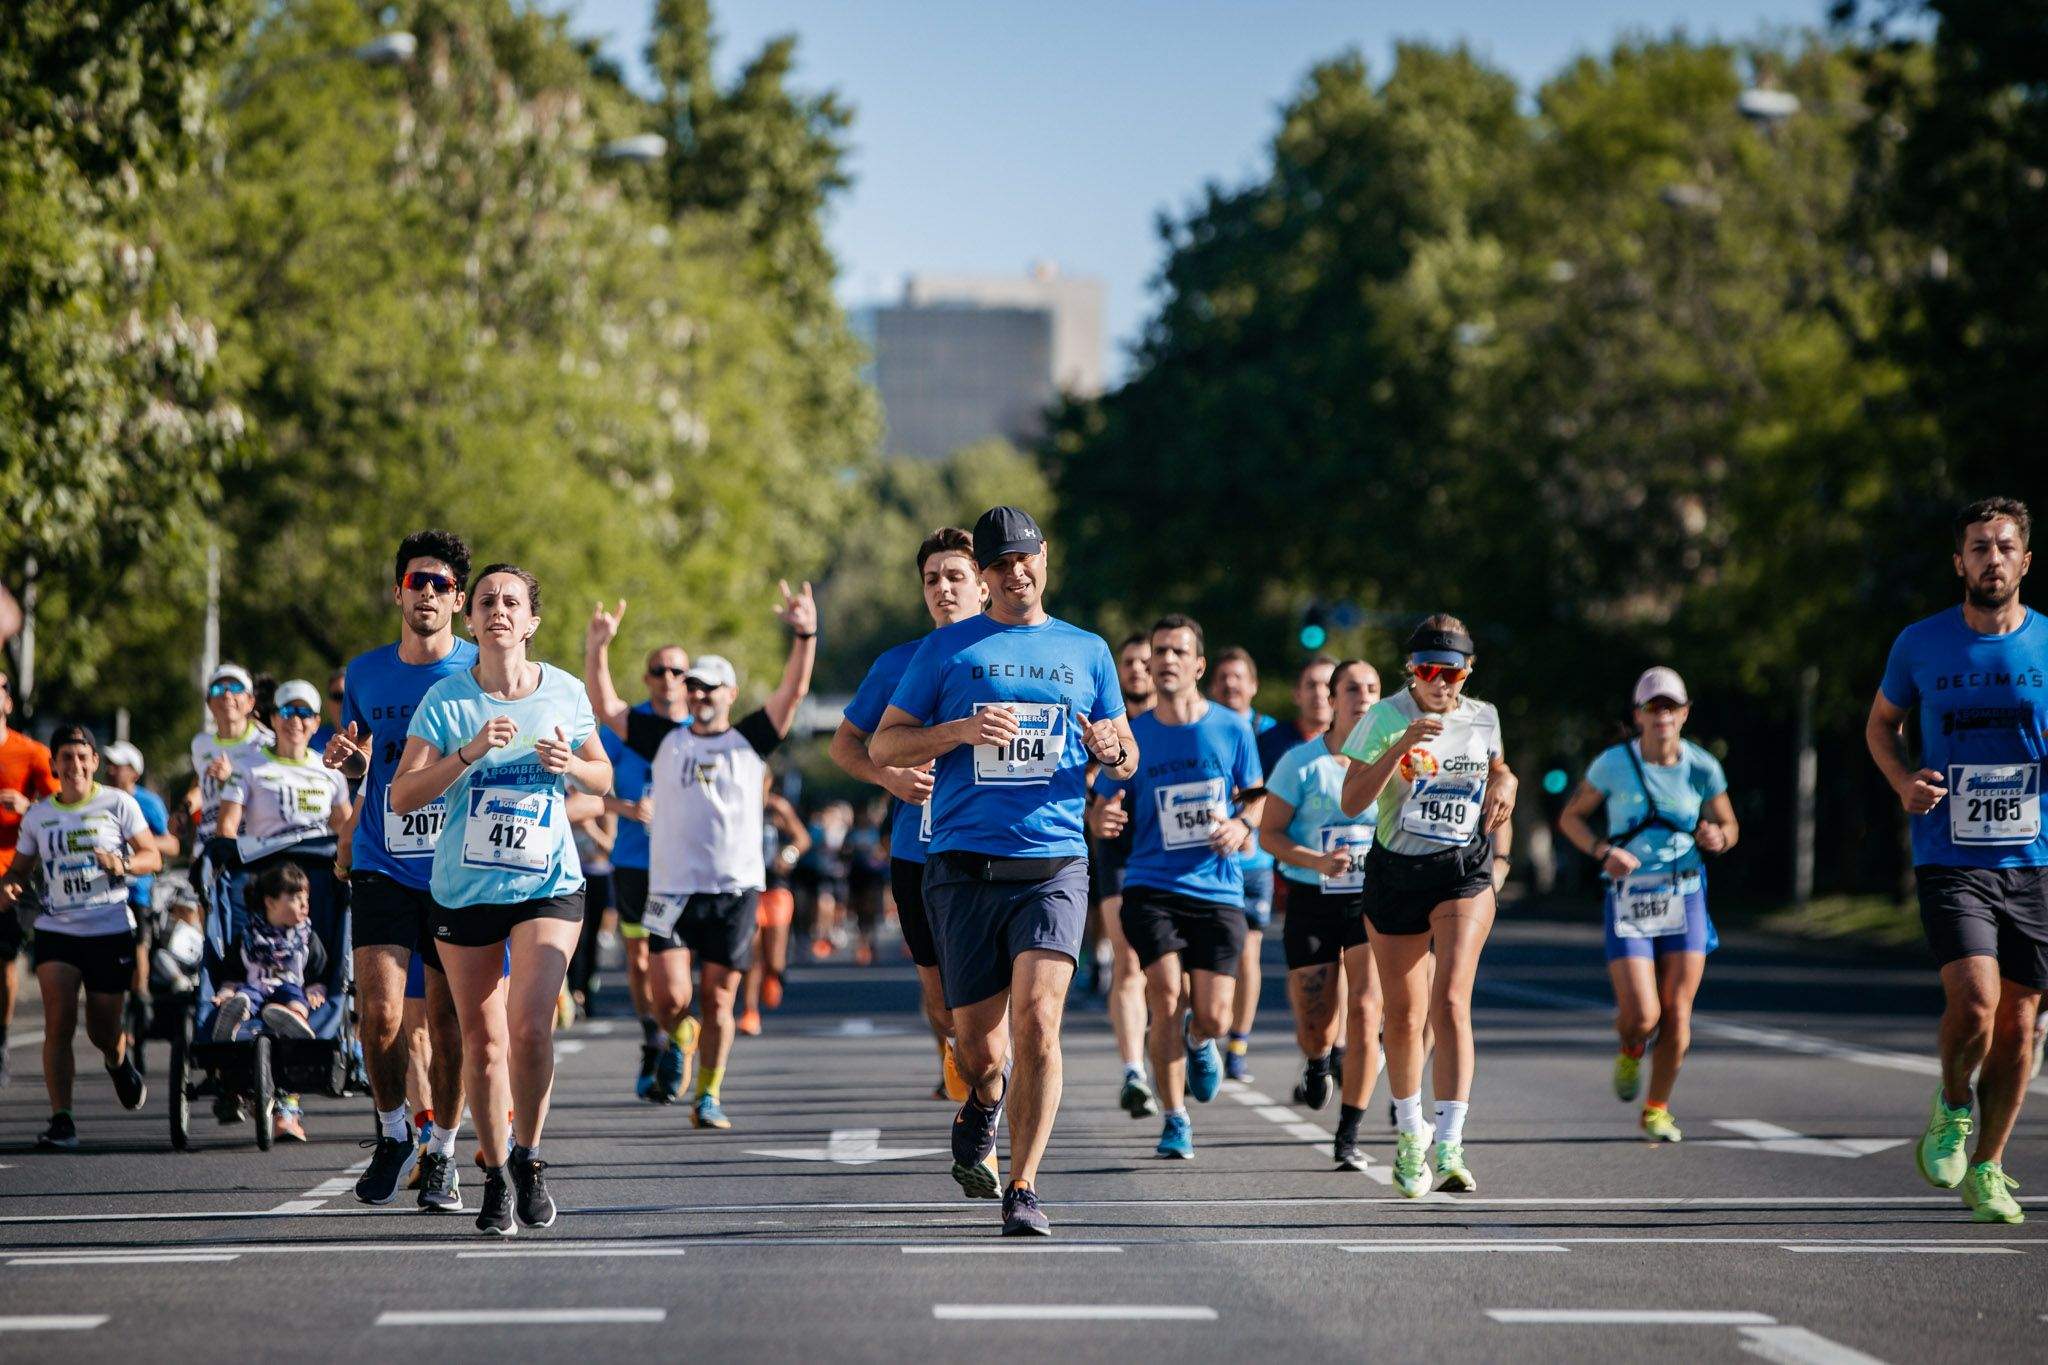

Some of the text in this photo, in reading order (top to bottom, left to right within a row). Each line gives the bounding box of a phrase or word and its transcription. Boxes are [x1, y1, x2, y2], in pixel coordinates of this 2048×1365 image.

[972, 664, 1074, 684] DECIMAS
[1936, 672, 2044, 691] DECIMAS
[1016, 714, 1047, 723] MBEROS
[1020, 729, 1046, 737] IMAS
[491, 764, 549, 777] BOMBER
[1419, 800, 1466, 825] 1949
[1967, 797, 2022, 822] 2165
[491, 813, 536, 827] DECIMAS
[488, 822, 528, 850] 412
